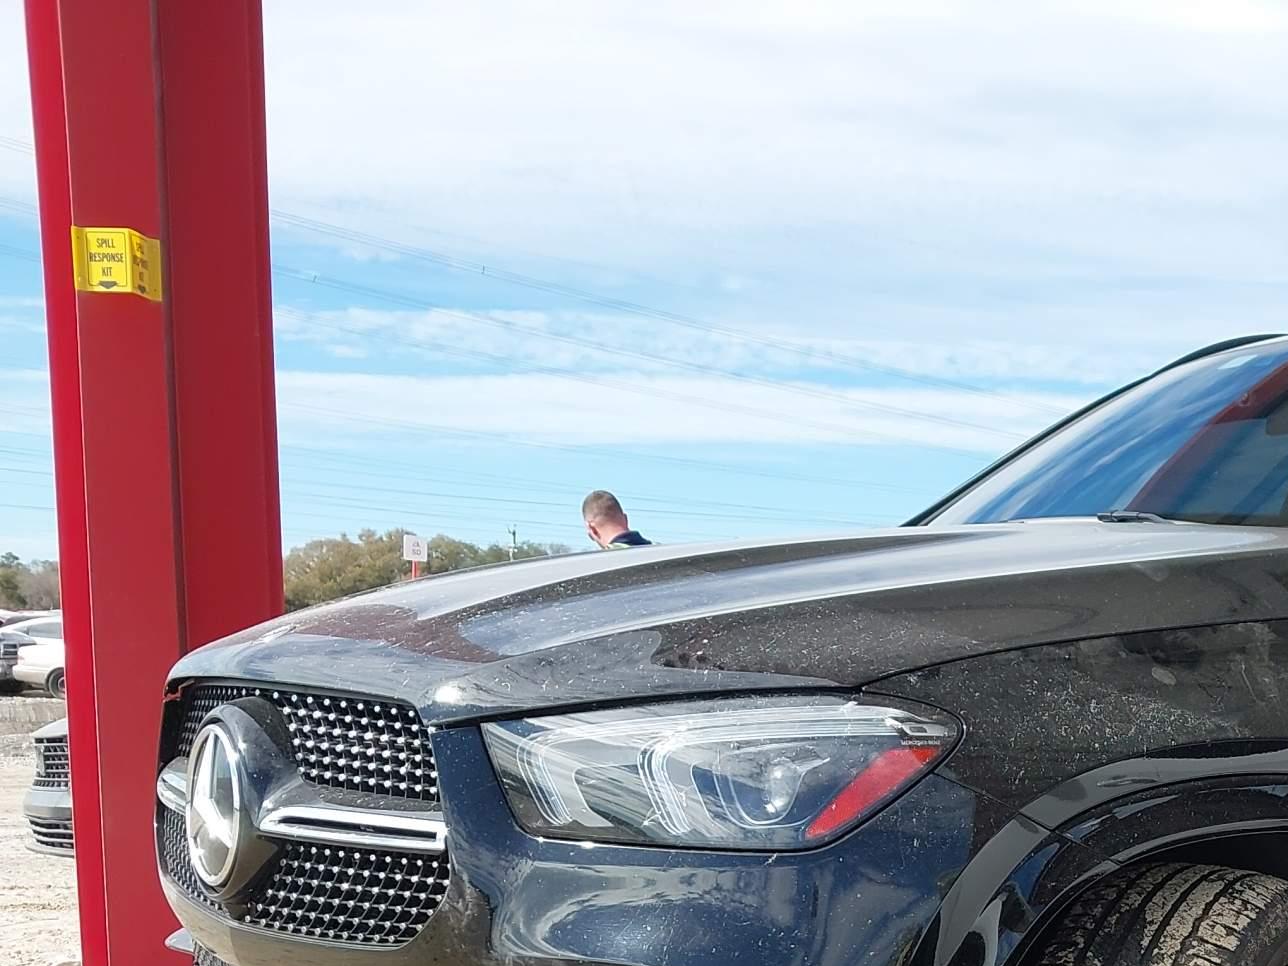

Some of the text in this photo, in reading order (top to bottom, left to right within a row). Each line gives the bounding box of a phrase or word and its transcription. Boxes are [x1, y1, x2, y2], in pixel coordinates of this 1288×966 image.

[96, 238, 115, 248] SPILL
[89, 252, 124, 262] RESPONSE
[101, 267, 112, 276] KIT
